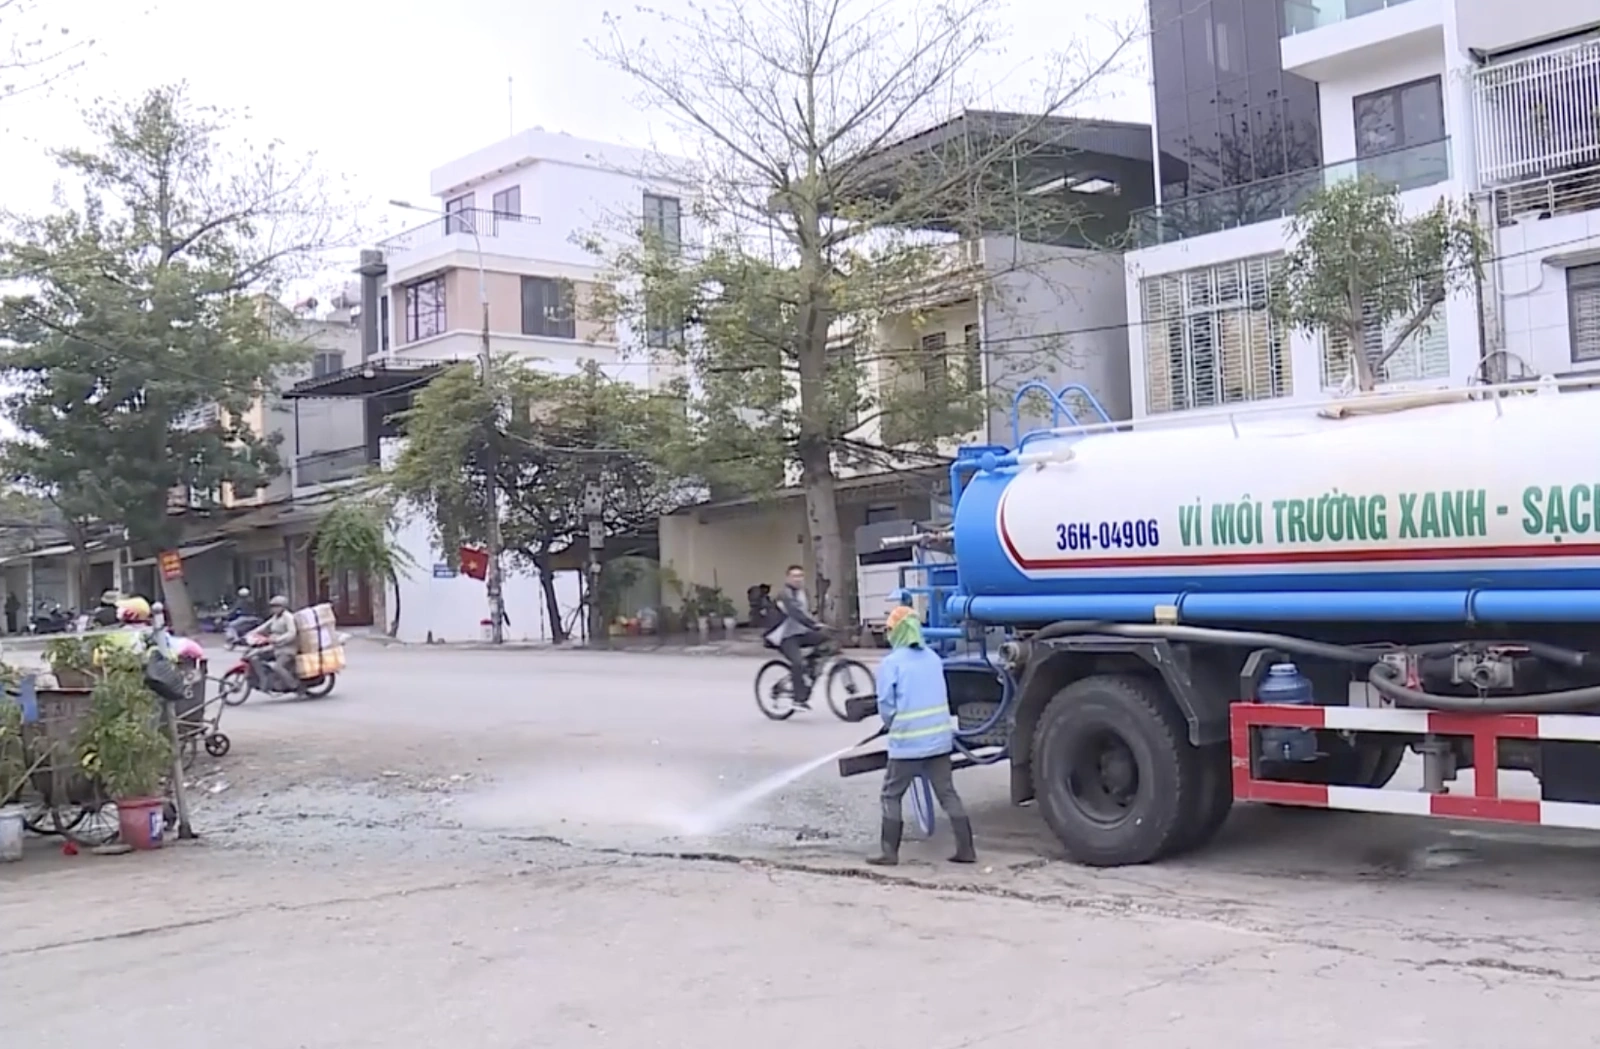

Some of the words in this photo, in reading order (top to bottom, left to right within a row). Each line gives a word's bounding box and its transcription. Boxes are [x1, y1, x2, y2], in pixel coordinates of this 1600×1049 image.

[1056, 518, 1159, 551] 36H-04906
[1211, 493, 1263, 545] MÔI
[1272, 487, 1387, 543] TRƯỜNG
[1398, 489, 1487, 539] XANH
